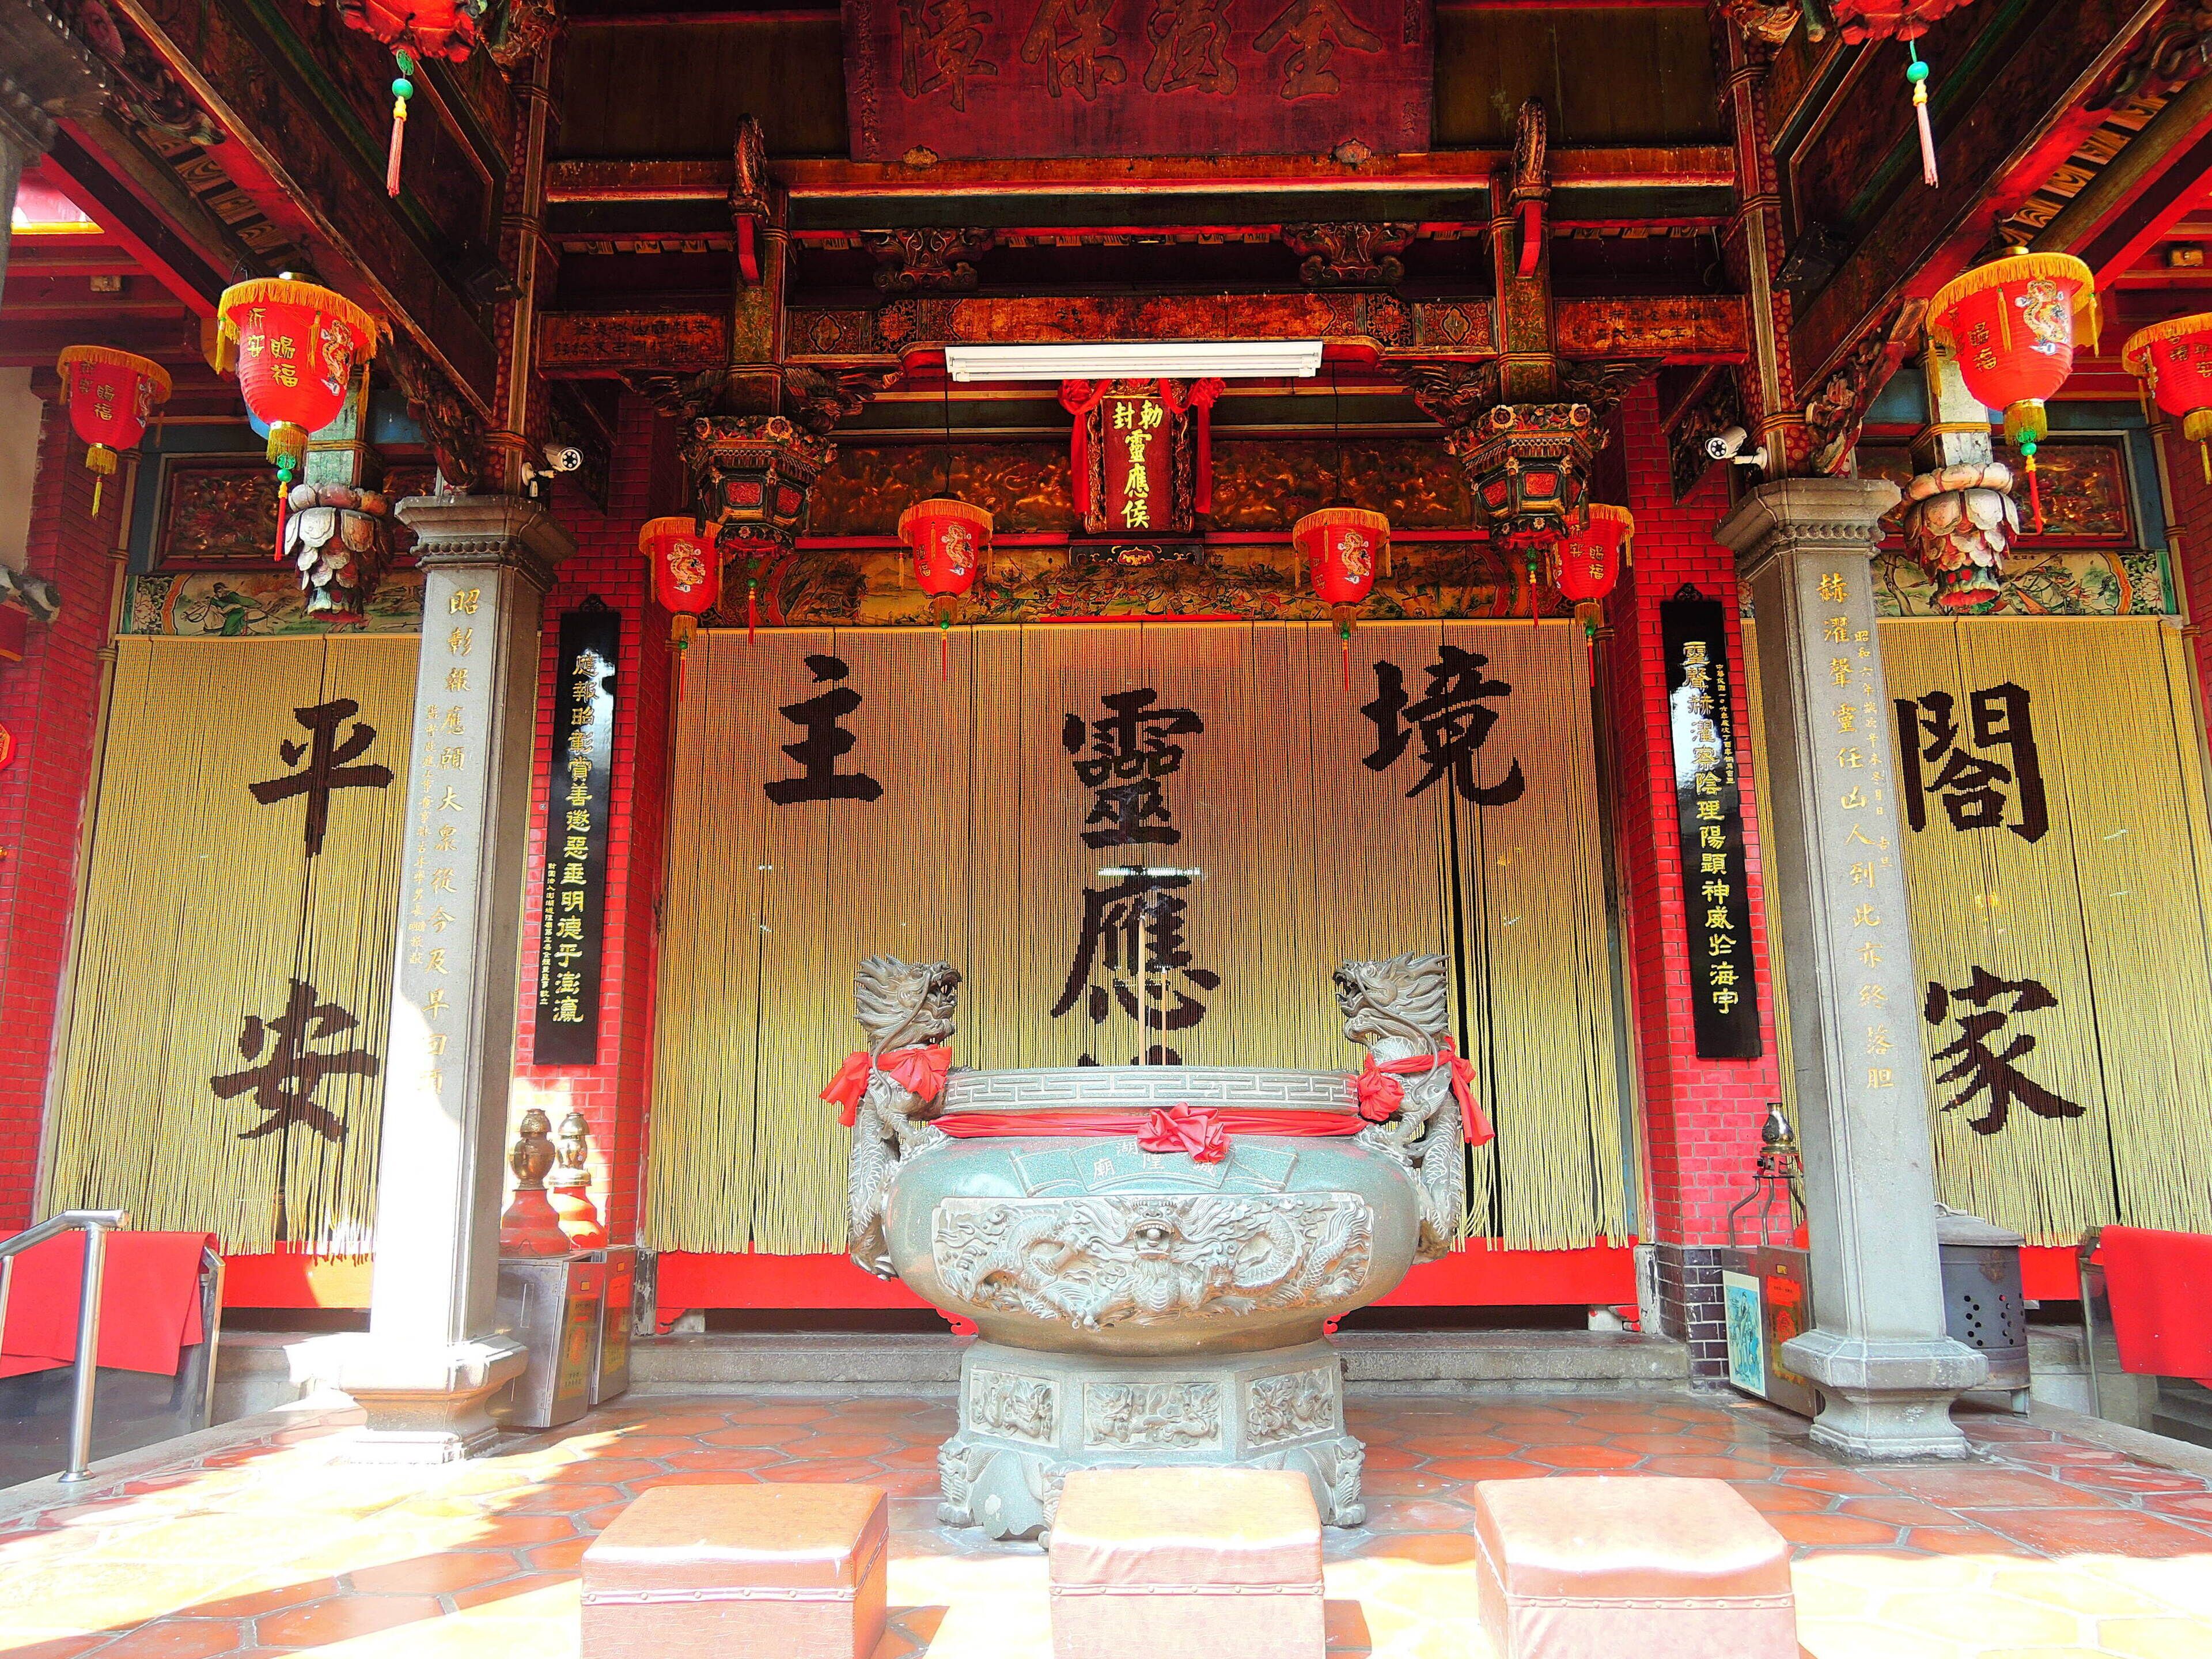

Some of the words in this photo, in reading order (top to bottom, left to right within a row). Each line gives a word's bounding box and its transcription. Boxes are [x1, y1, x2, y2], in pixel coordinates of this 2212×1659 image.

[271, 336, 298, 388] 賜福
[764, 654, 884, 805] 主
[1361, 645, 1525, 806] 境
[210, 697, 395, 1144] 平安
[1051, 687, 1221, 1066] 靈應
